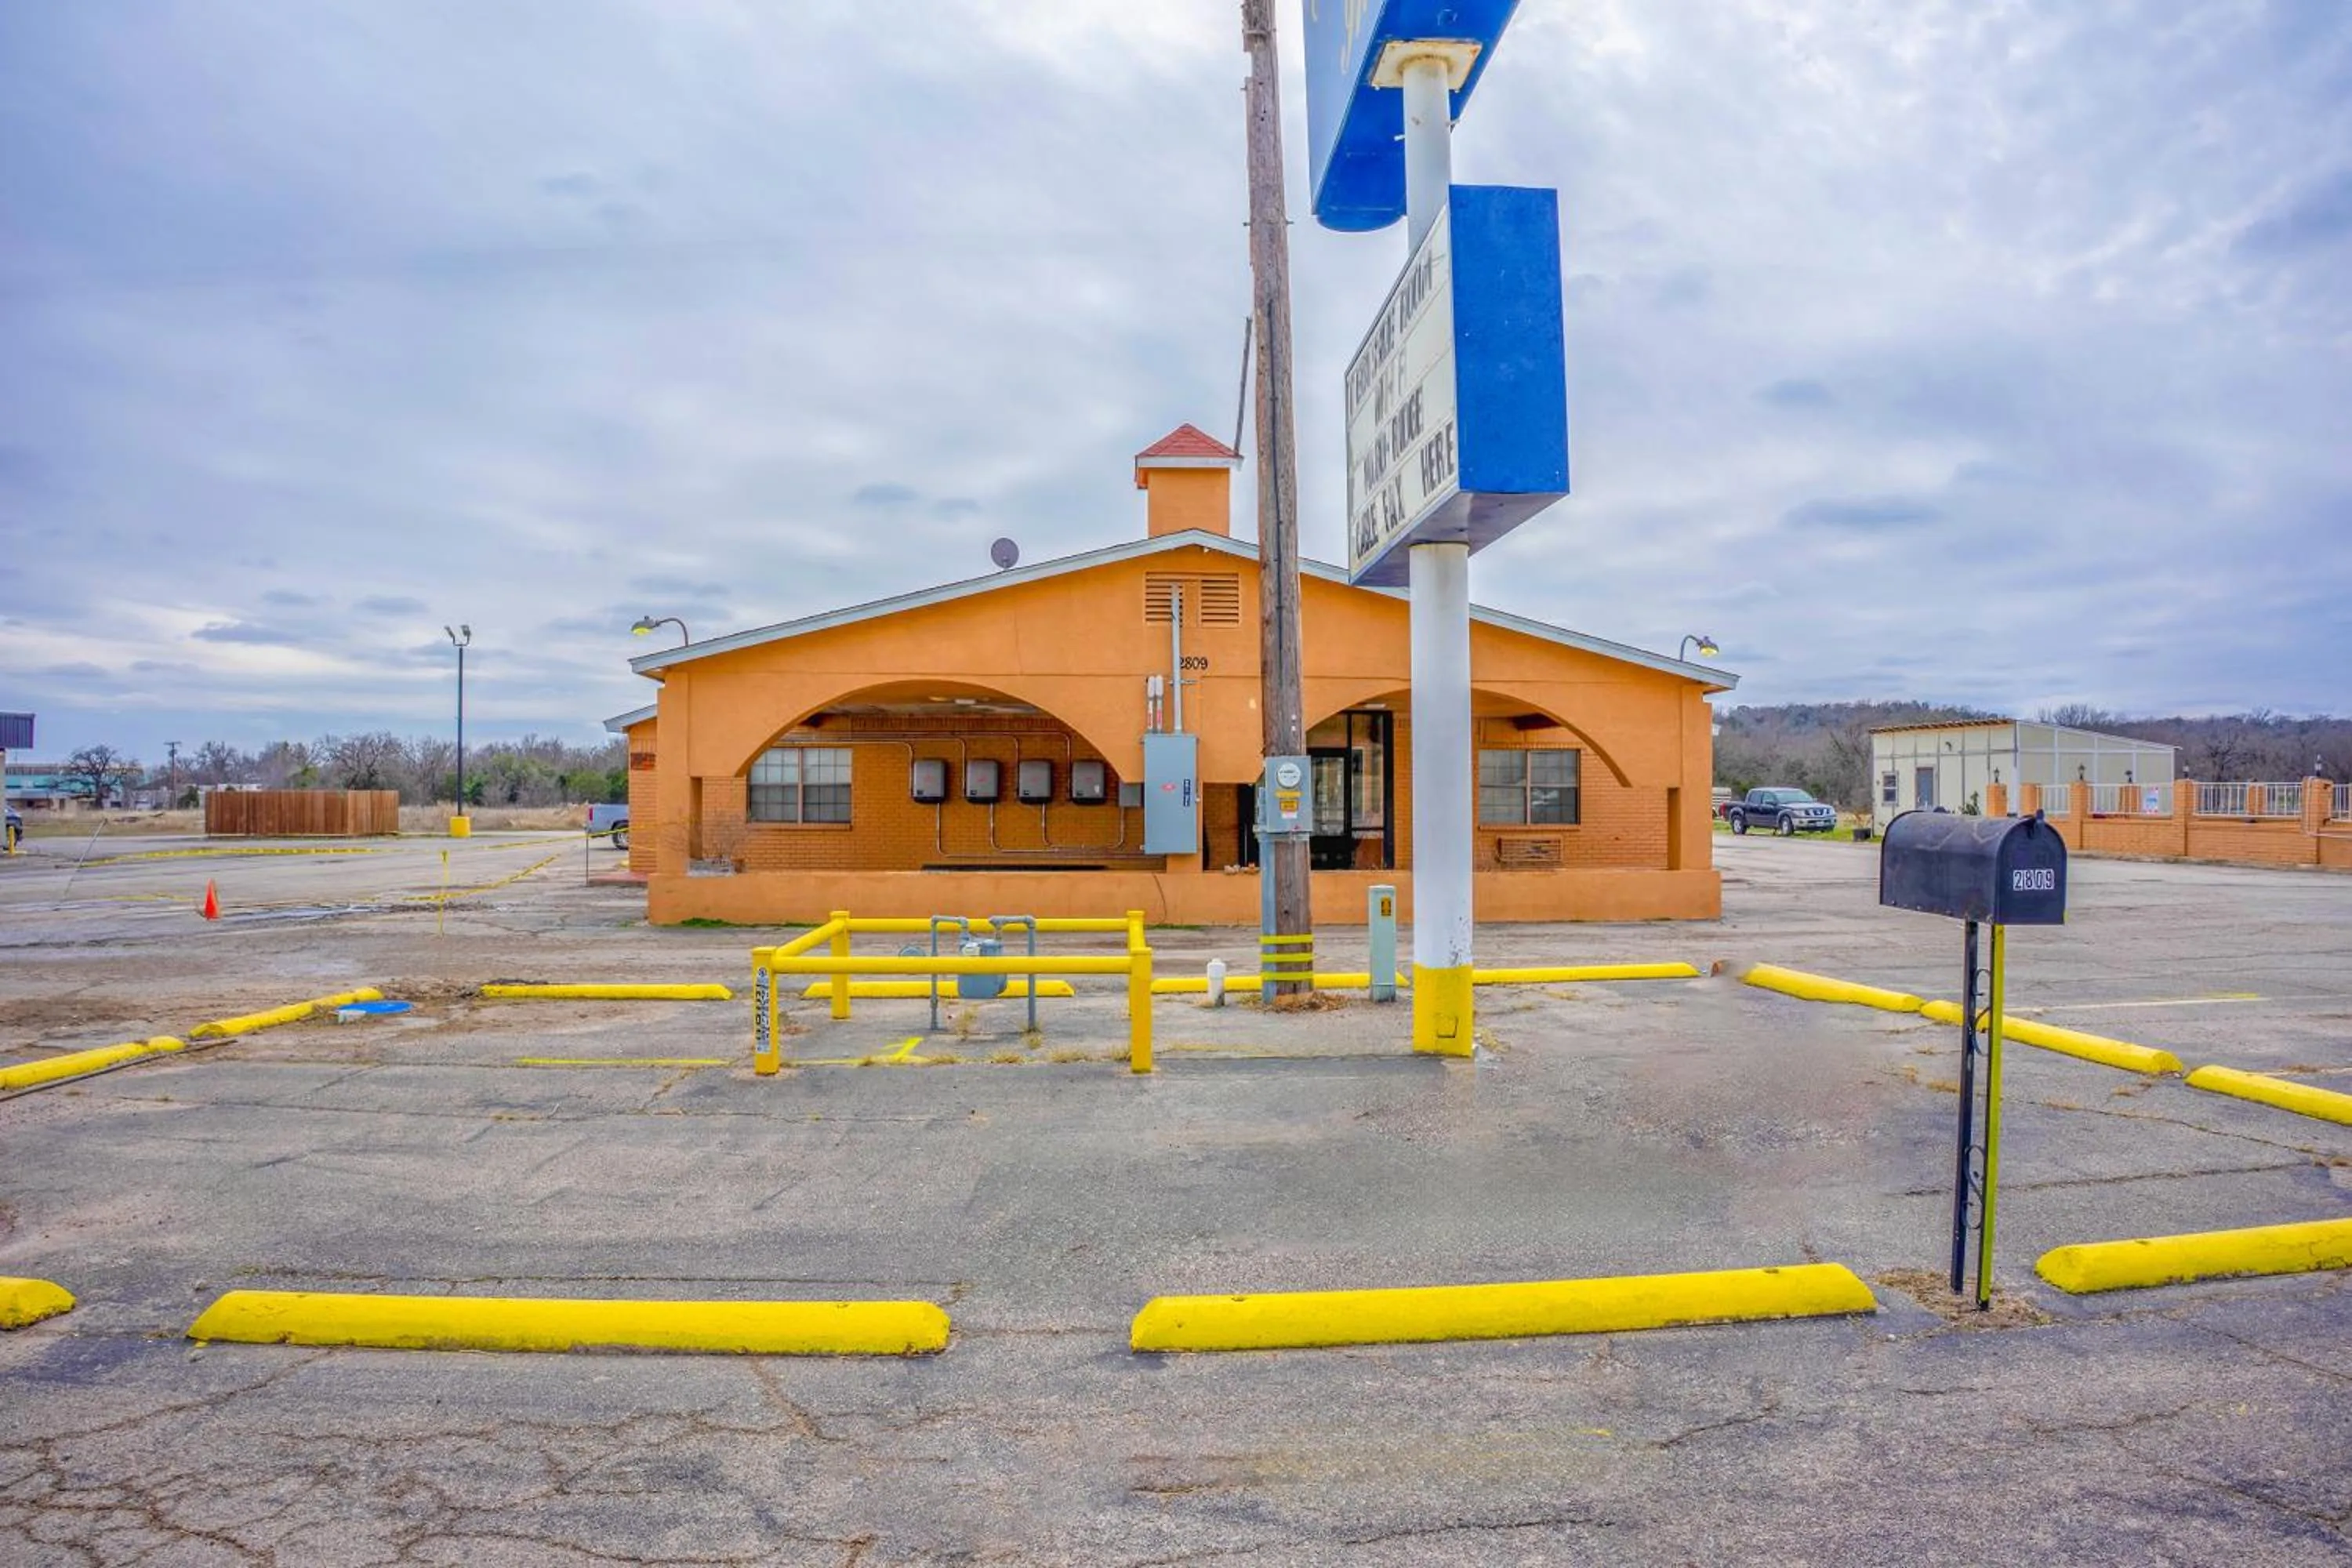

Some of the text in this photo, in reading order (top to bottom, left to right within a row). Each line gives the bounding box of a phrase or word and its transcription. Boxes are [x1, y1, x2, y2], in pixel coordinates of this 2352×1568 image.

[1421, 421, 1454, 497] HERE
[1179, 656, 1208, 670] 2809
[2014, 870, 2053, 890] 2809
